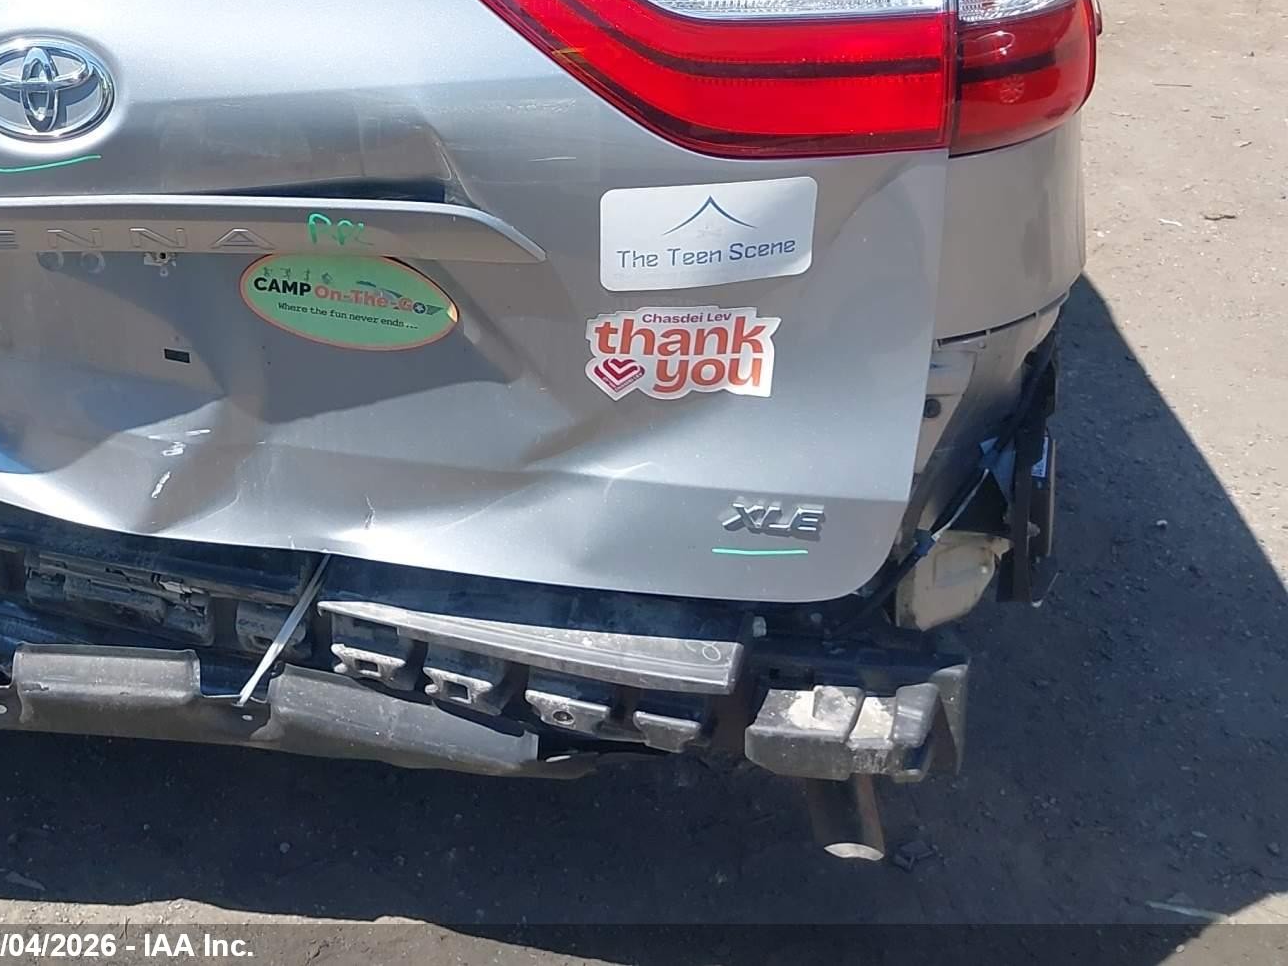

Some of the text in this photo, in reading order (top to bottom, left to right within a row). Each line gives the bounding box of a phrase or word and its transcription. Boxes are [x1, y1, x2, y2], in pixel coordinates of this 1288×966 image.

[616, 239, 796, 269] The Teen Scene
[253, 276, 311, 297] CAMP
[278, 301, 308, 315] Where
[310, 305, 327, 317] the
[329, 308, 347, 321] fun
[348, 313, 379, 326] never
[642, 312, 732, 324] Chasdei Lev
[594, 316, 766, 356] thank
[652, 357, 763, 394] you
[722, 503, 824, 536] XLE
